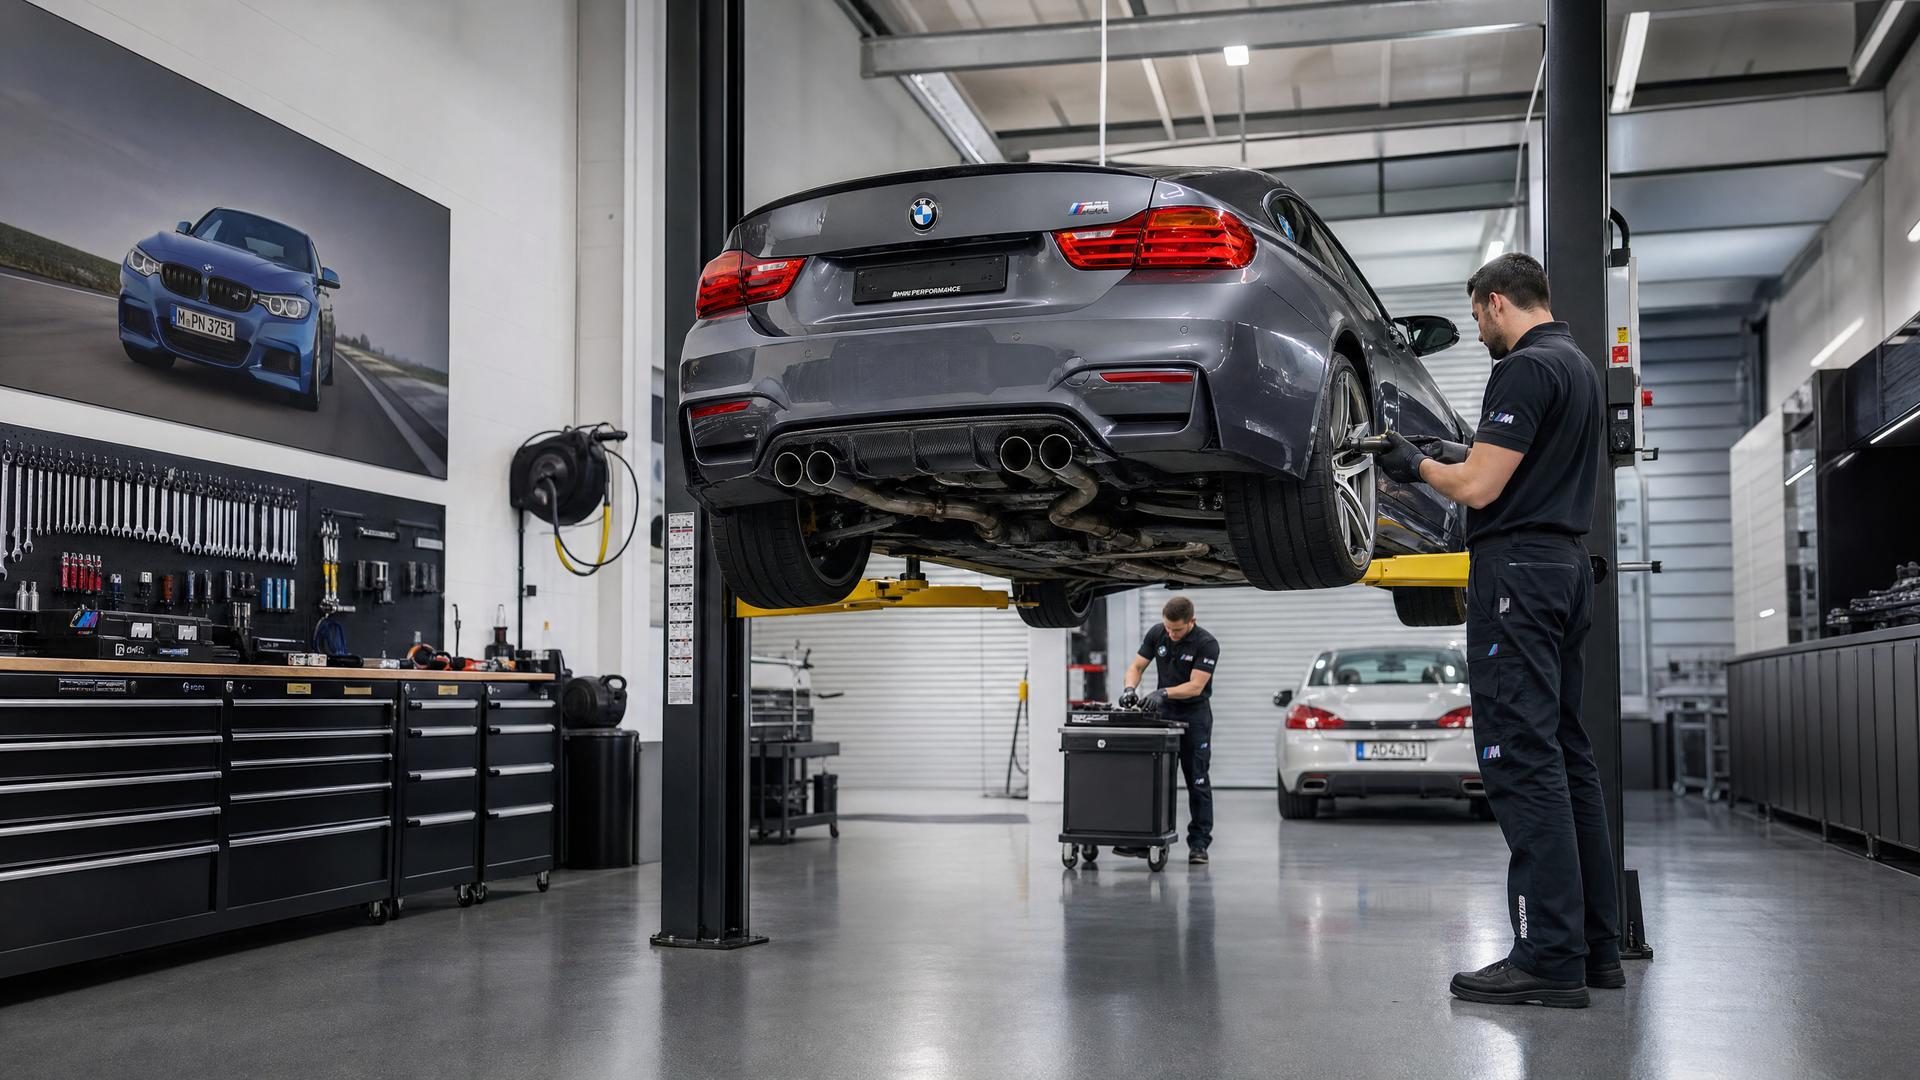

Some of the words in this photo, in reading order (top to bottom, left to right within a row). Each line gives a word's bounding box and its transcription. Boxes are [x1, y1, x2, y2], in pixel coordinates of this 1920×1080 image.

[911, 285, 961, 296] PERFORMANCE
[177, 309, 186, 326] M
[191, 313, 206, 331] PN
[207, 318, 234, 339] 3751
